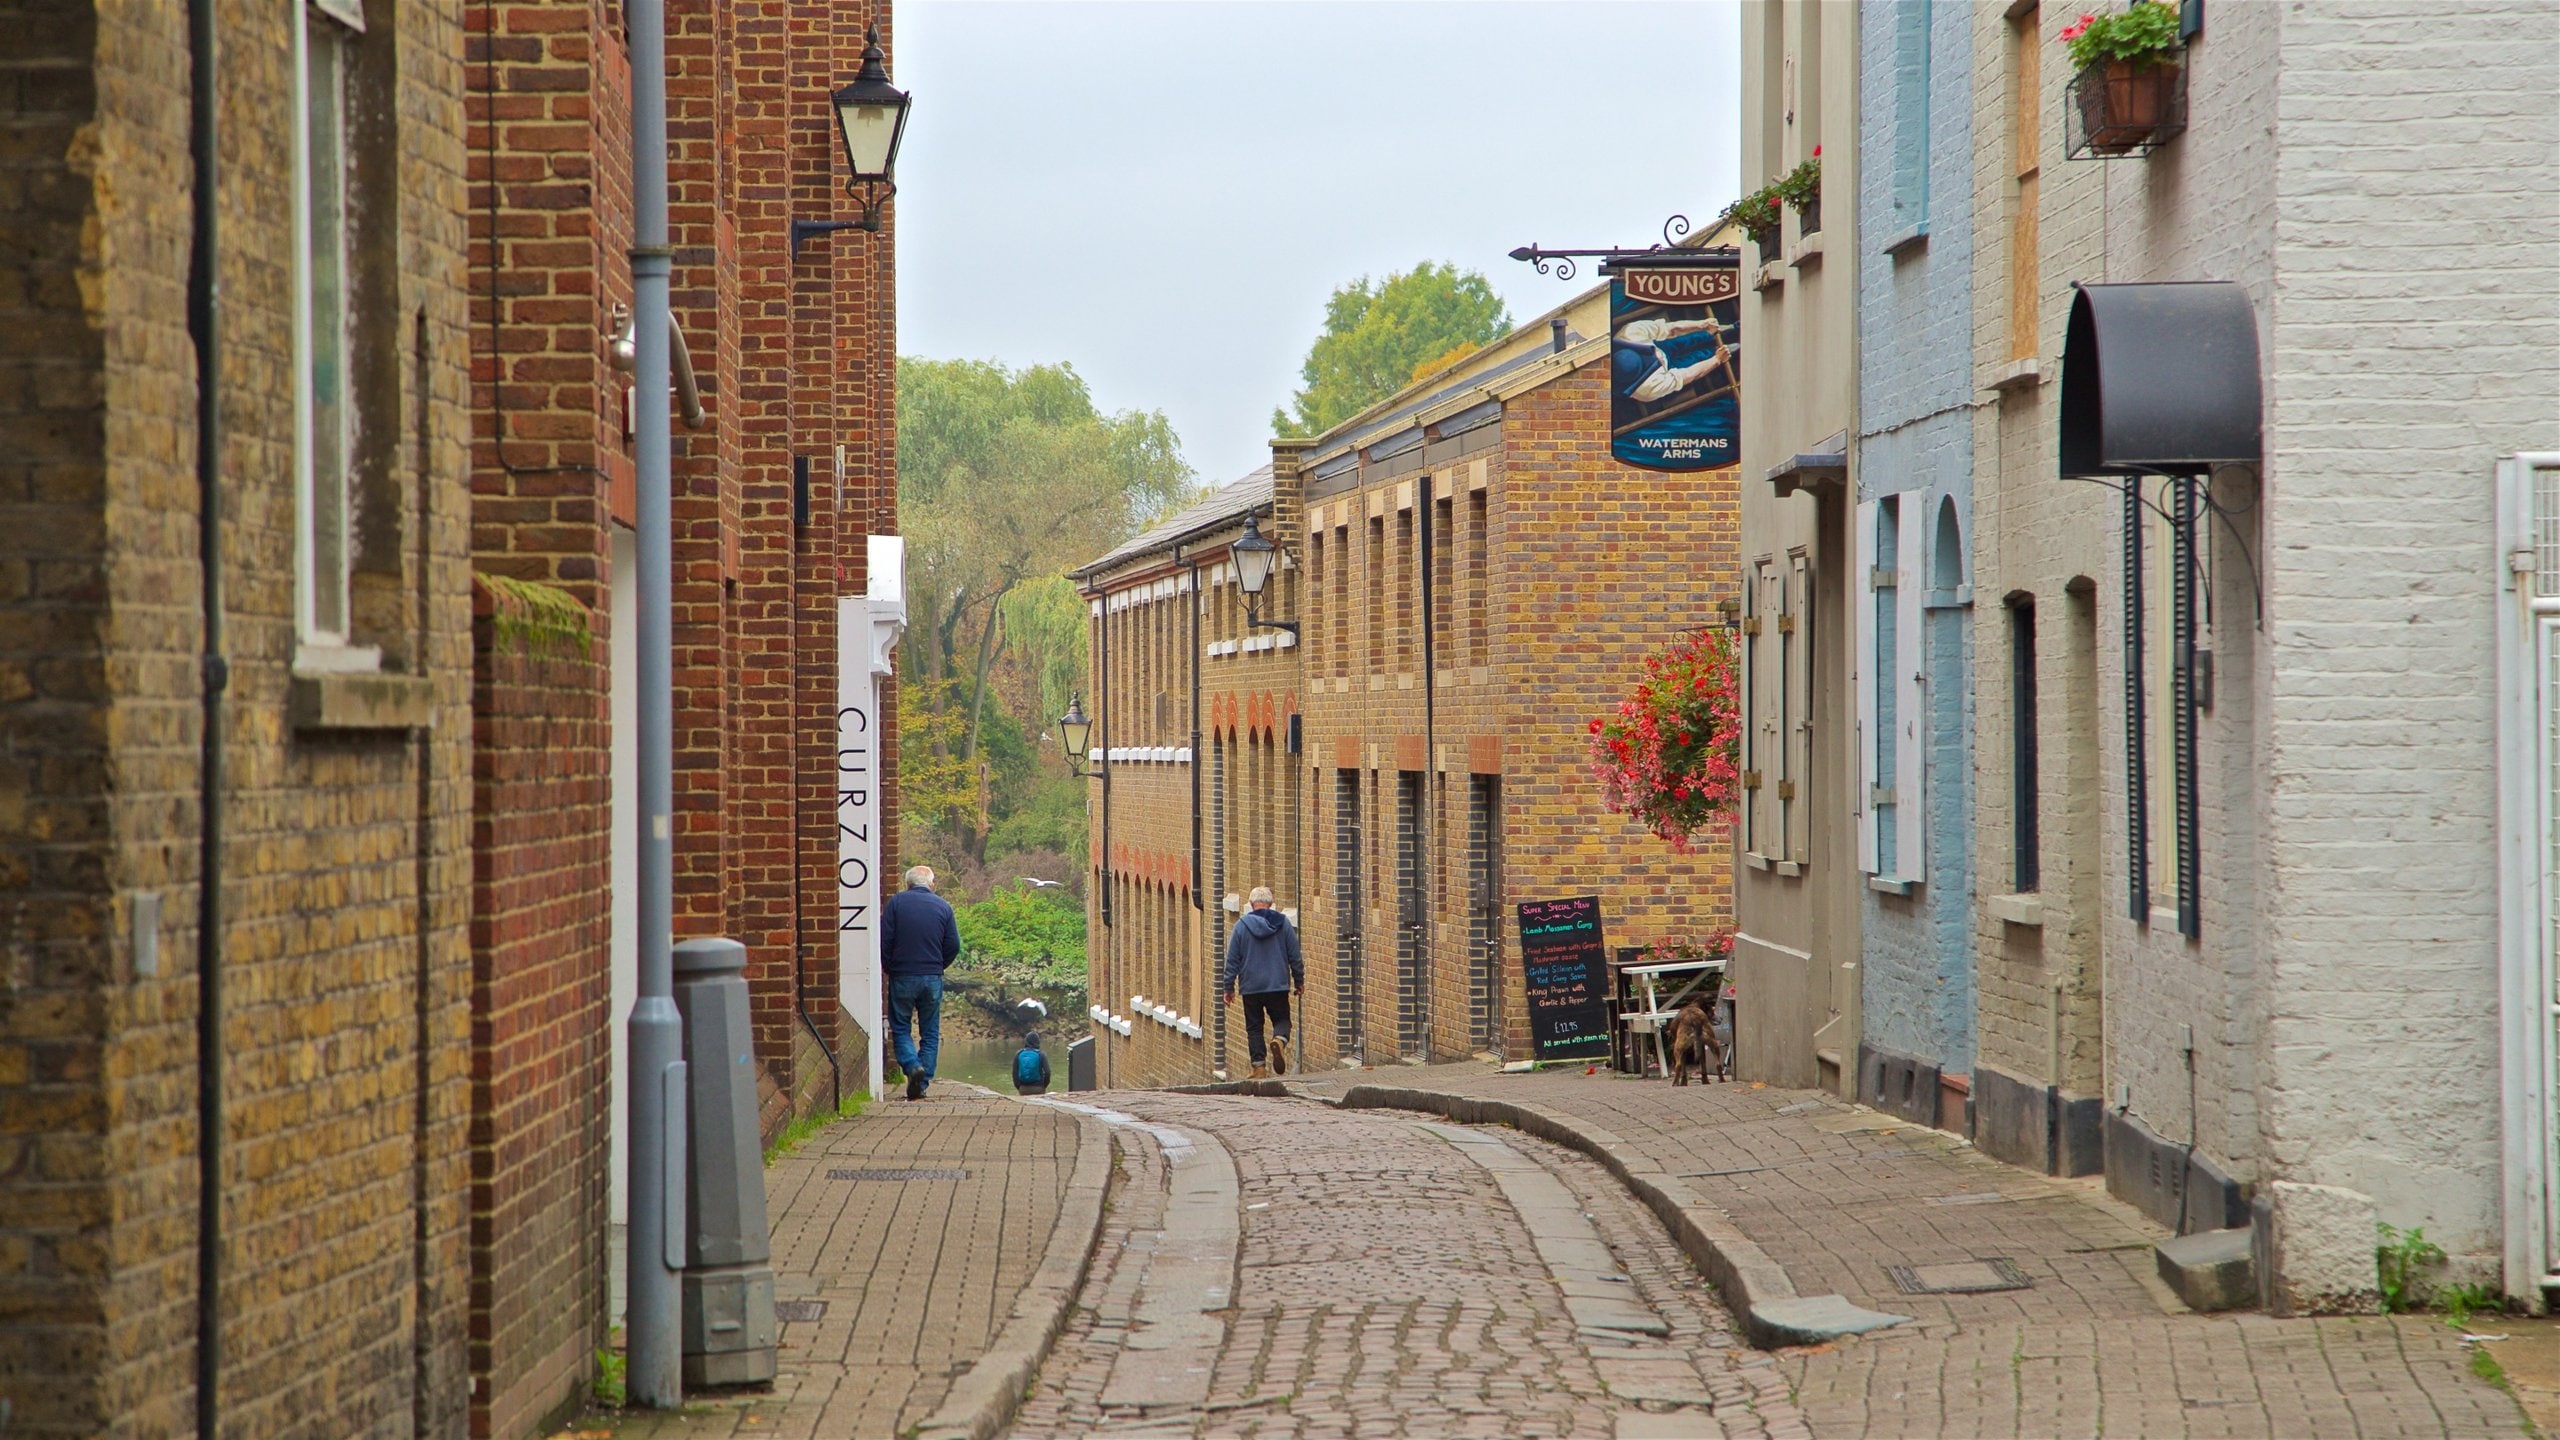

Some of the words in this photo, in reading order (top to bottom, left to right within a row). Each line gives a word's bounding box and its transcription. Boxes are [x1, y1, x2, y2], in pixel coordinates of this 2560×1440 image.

[1634, 273, 1730, 296] YOUNG'S
[1638, 438, 1728, 448] WATERMANS
[1662, 448, 1701, 459] ARMS
[838, 707, 868, 930] CURZON
[1531, 988, 1548, 999] King
[1560, 997, 1567, 1006] &
